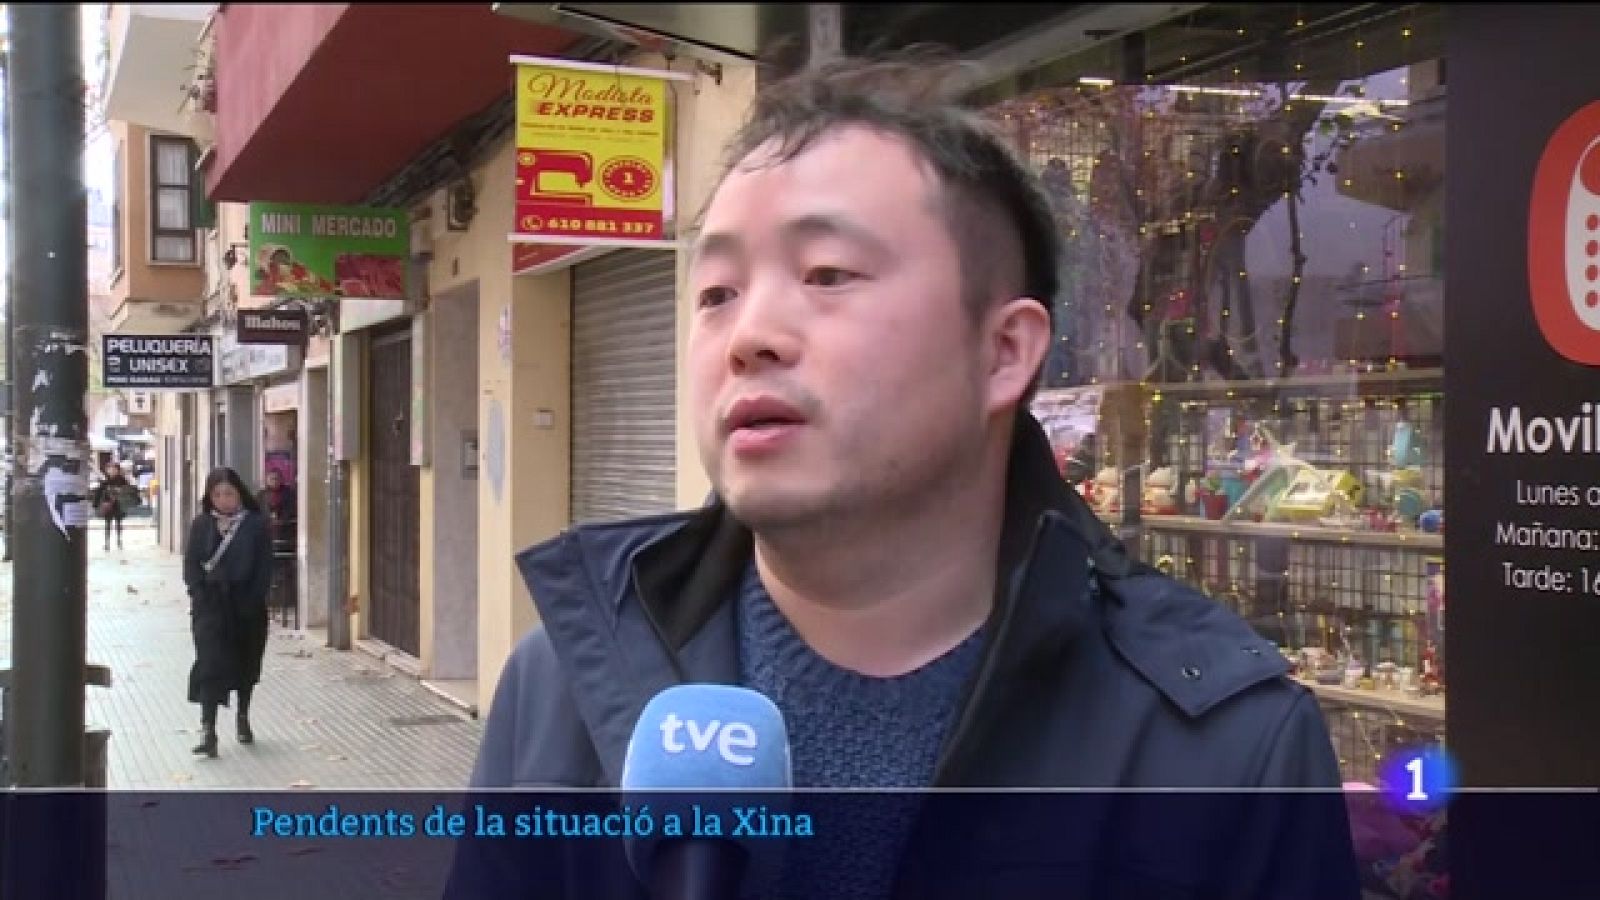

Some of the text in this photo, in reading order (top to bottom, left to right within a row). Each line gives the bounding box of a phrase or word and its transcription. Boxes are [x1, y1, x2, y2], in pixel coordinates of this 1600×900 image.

[536, 102, 655, 123] EXPRESS
[262, 212, 397, 239] MINI MERCADO
[547, 217, 581, 231] 610
[245, 314, 301, 331] Mahou
[106, 337, 211, 356] PELUQUERÍA
[129, 356, 189, 374] UNISEX
[1516, 479, 1580, 507] Lunes
[1495, 520, 1600, 551] Mañana:
[1502, 560, 1573, 594] Tarde:
[661, 713, 757, 766] tve
